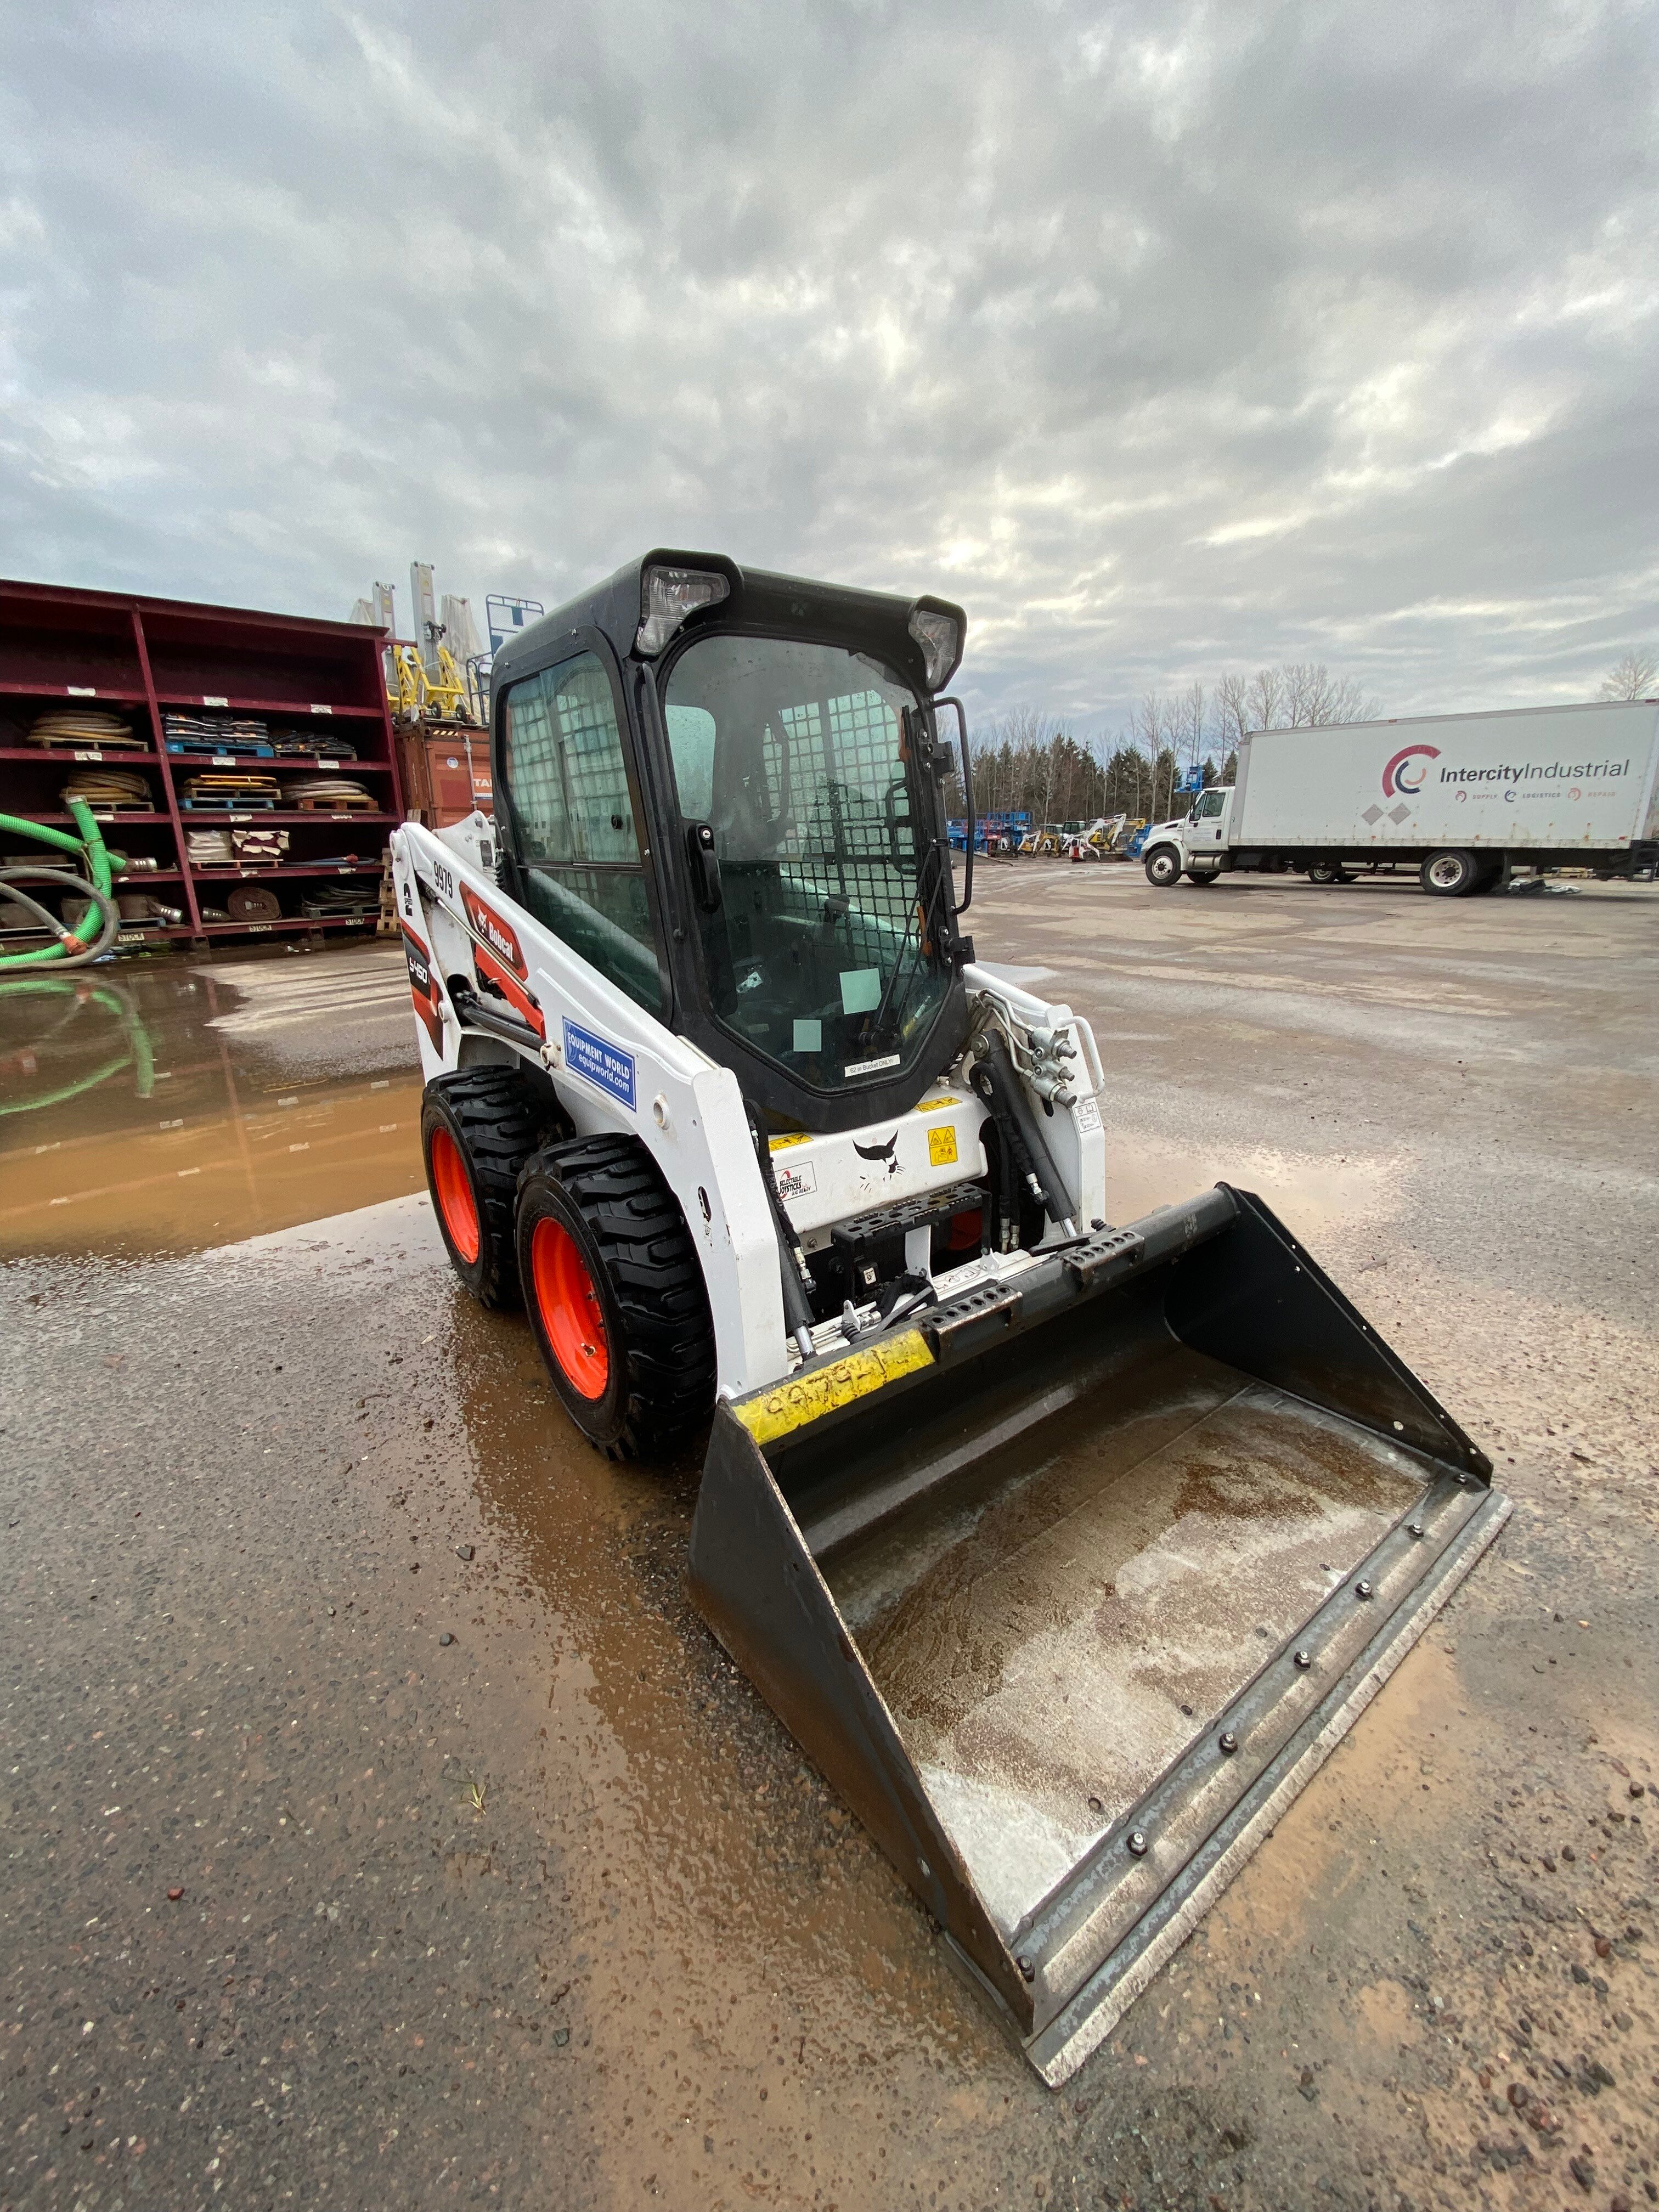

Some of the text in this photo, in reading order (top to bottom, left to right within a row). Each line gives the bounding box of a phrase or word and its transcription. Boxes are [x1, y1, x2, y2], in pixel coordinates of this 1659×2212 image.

[473, 778, 493, 787] TA
[1440, 759, 1630, 783] IntercityIndustrial
[434, 861, 453, 898] 9979
[489, 921, 514, 962] Bobcat
[409, 957, 427, 984] S450
[567, 1032, 630, 1080] EQUIPMENT WORLD
[578, 1054, 630, 1093] equipworld.com
[778, 1182, 802, 1195] JOYSTICKS
[780, 1175, 802, 1187] SELECTABLE
